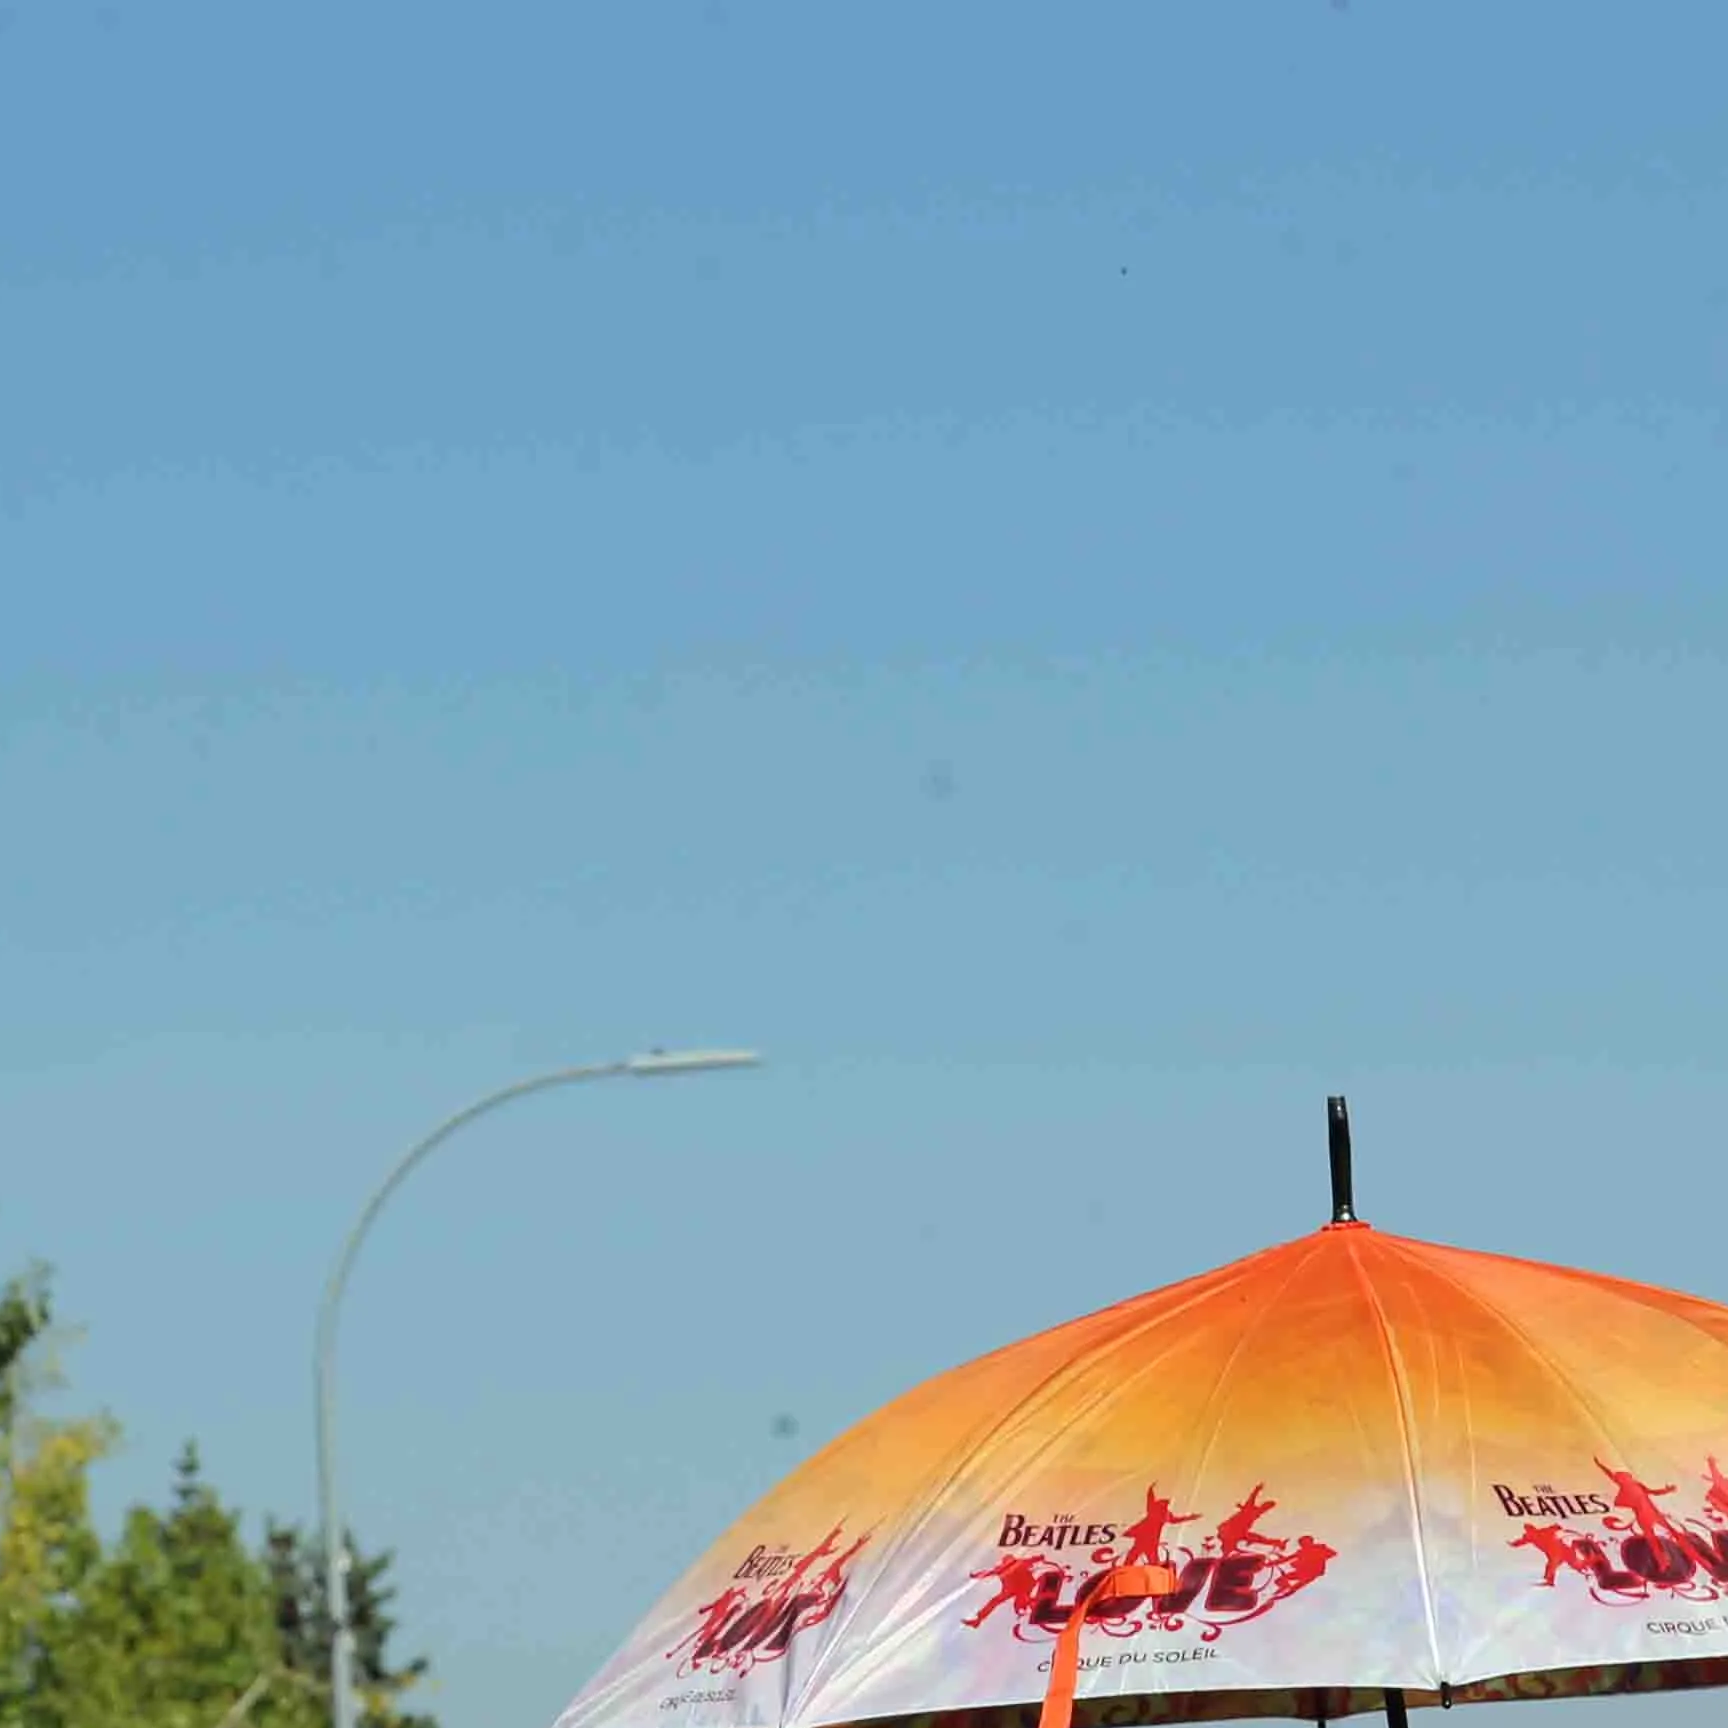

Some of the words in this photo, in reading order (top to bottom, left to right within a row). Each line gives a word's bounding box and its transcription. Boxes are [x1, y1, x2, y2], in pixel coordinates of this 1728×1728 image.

[1492, 1483, 1611, 1521] BEATLES
[998, 1512, 1117, 1551] BEATLES
[1646, 1617, 1717, 1637] CIRQUE
[1037, 1655, 1114, 1672] CQUE
[1119, 1652, 1146, 1665] DU
[1151, 1646, 1220, 1663] SOLEIL
